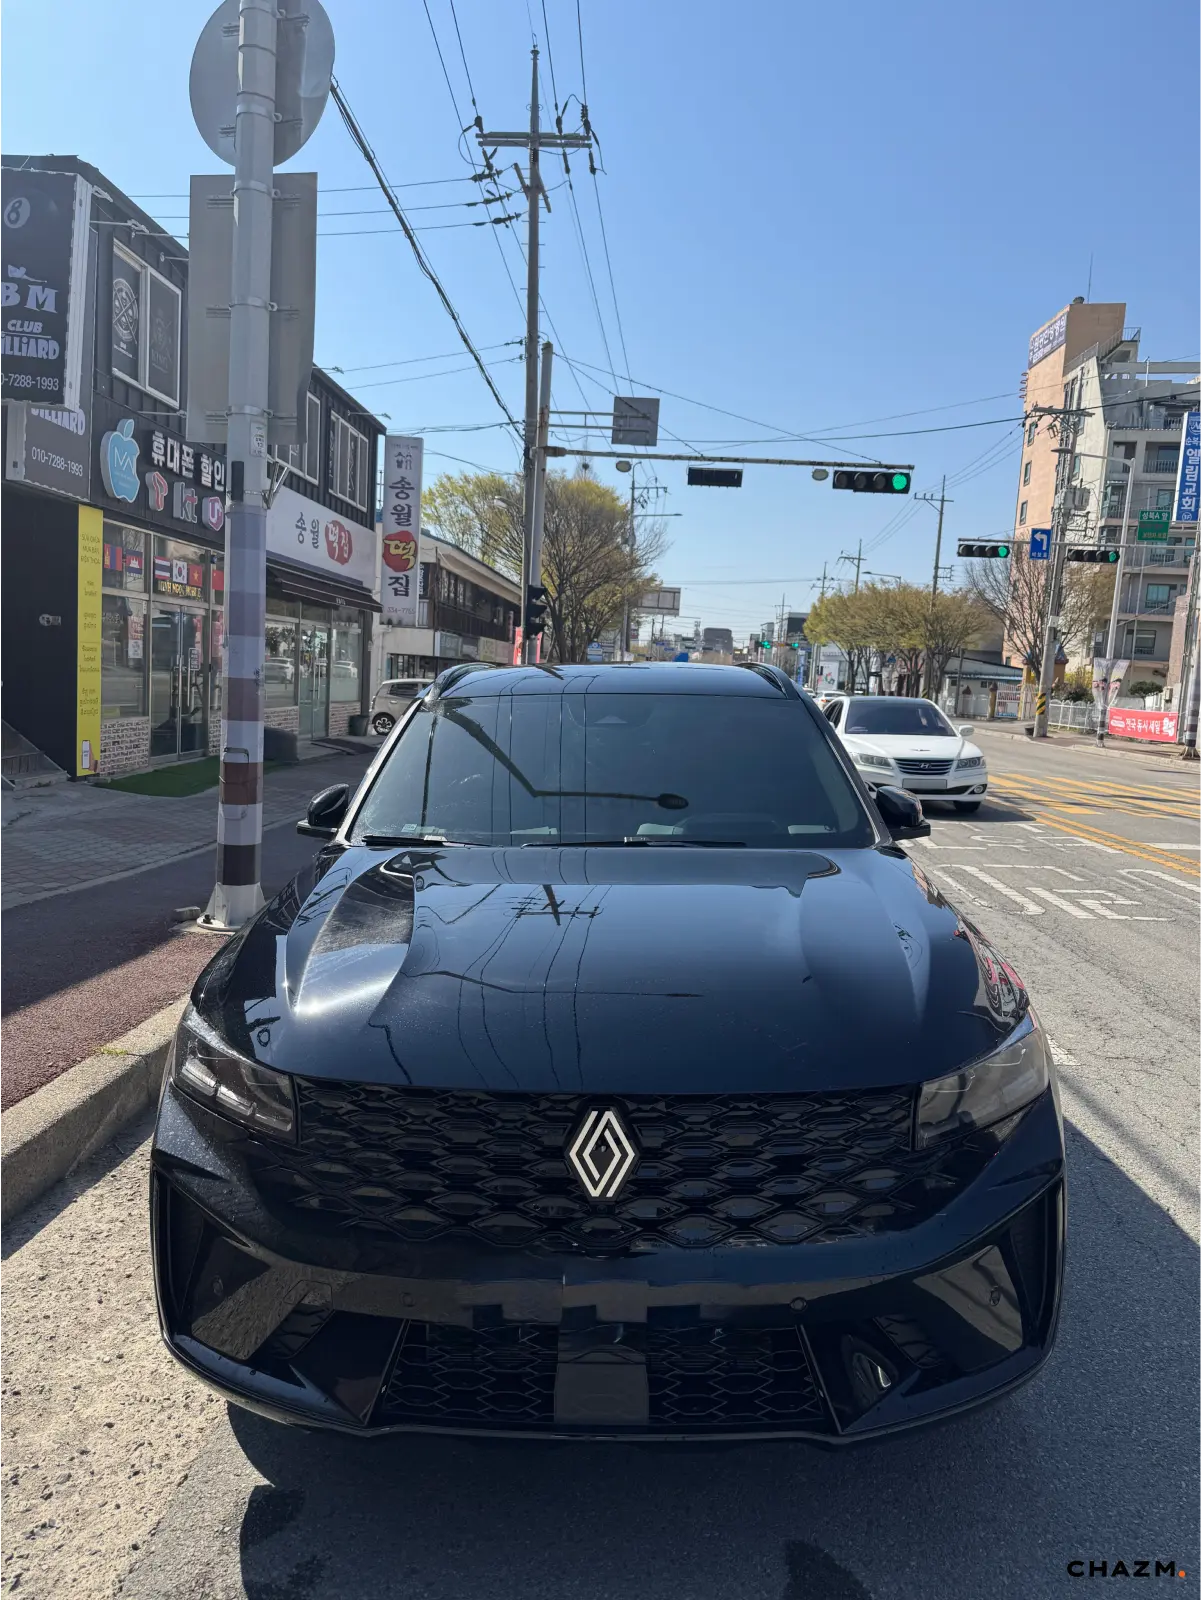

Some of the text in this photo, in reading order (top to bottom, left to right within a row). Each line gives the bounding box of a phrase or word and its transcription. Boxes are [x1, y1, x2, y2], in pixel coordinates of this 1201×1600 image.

[7, 320, 43, 333] CLUB
[1186, 436, 1201, 446] 순복
[31, 446, 83, 477] 010-7288-1993
[151, 430, 225, 492] 휴대폰 할인
[1181, 448, 1201, 512] 엘림교회
